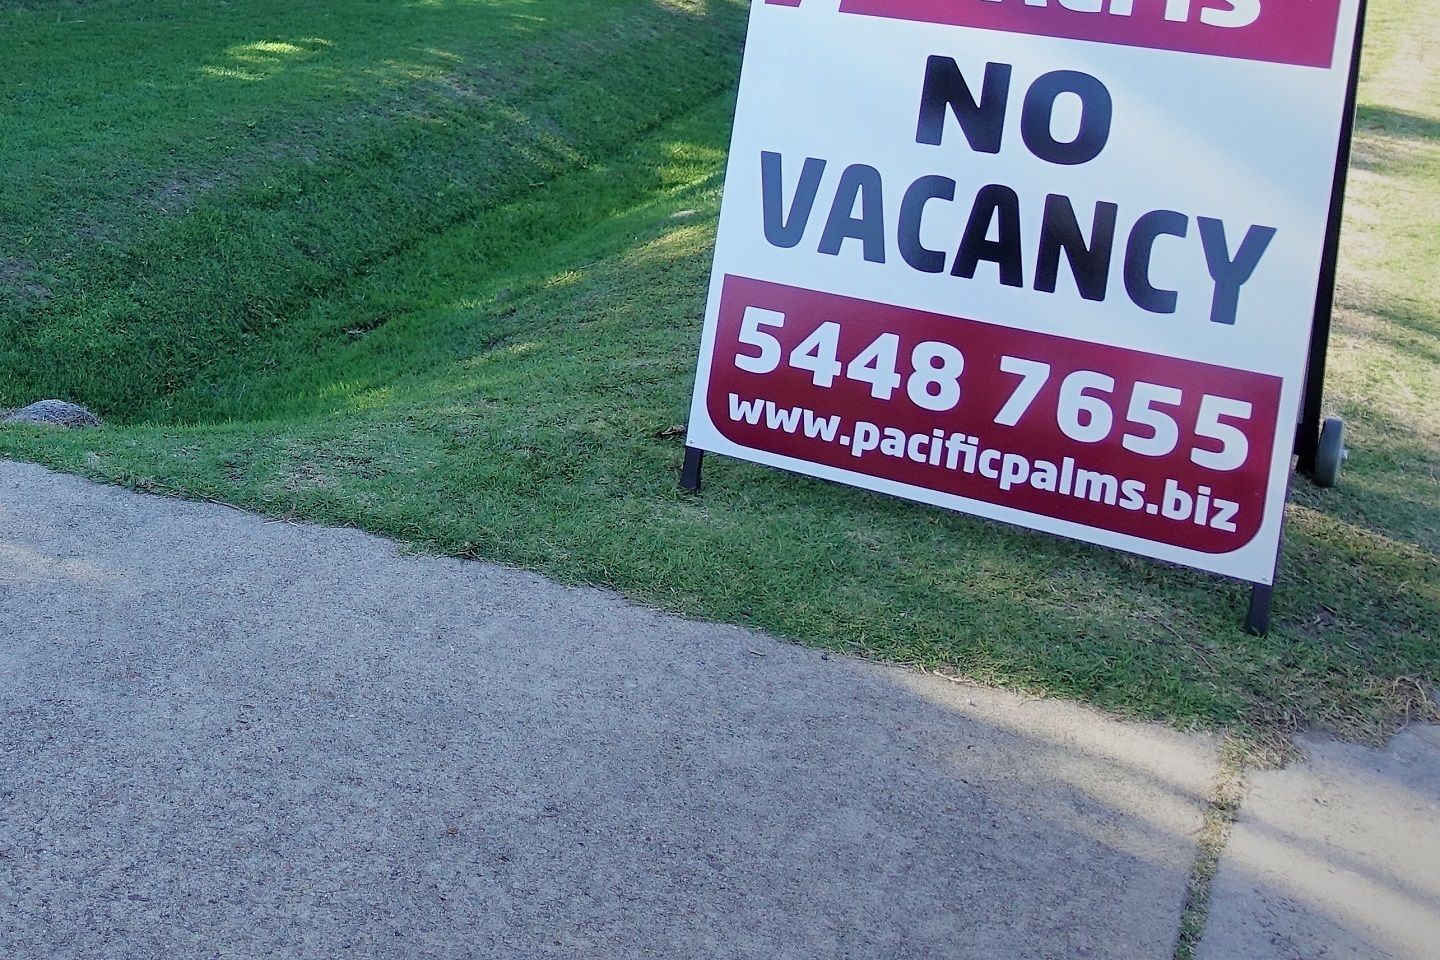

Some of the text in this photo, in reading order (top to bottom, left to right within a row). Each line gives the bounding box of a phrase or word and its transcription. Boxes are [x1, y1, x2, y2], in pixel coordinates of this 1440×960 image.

[914, 54, 1114, 166] NO
[759, 150, 1279, 326] VACANCY
[727, 391, 1240, 534] www.pacificpalms.biz
[733, 305, 1254, 472] 5448 7655
